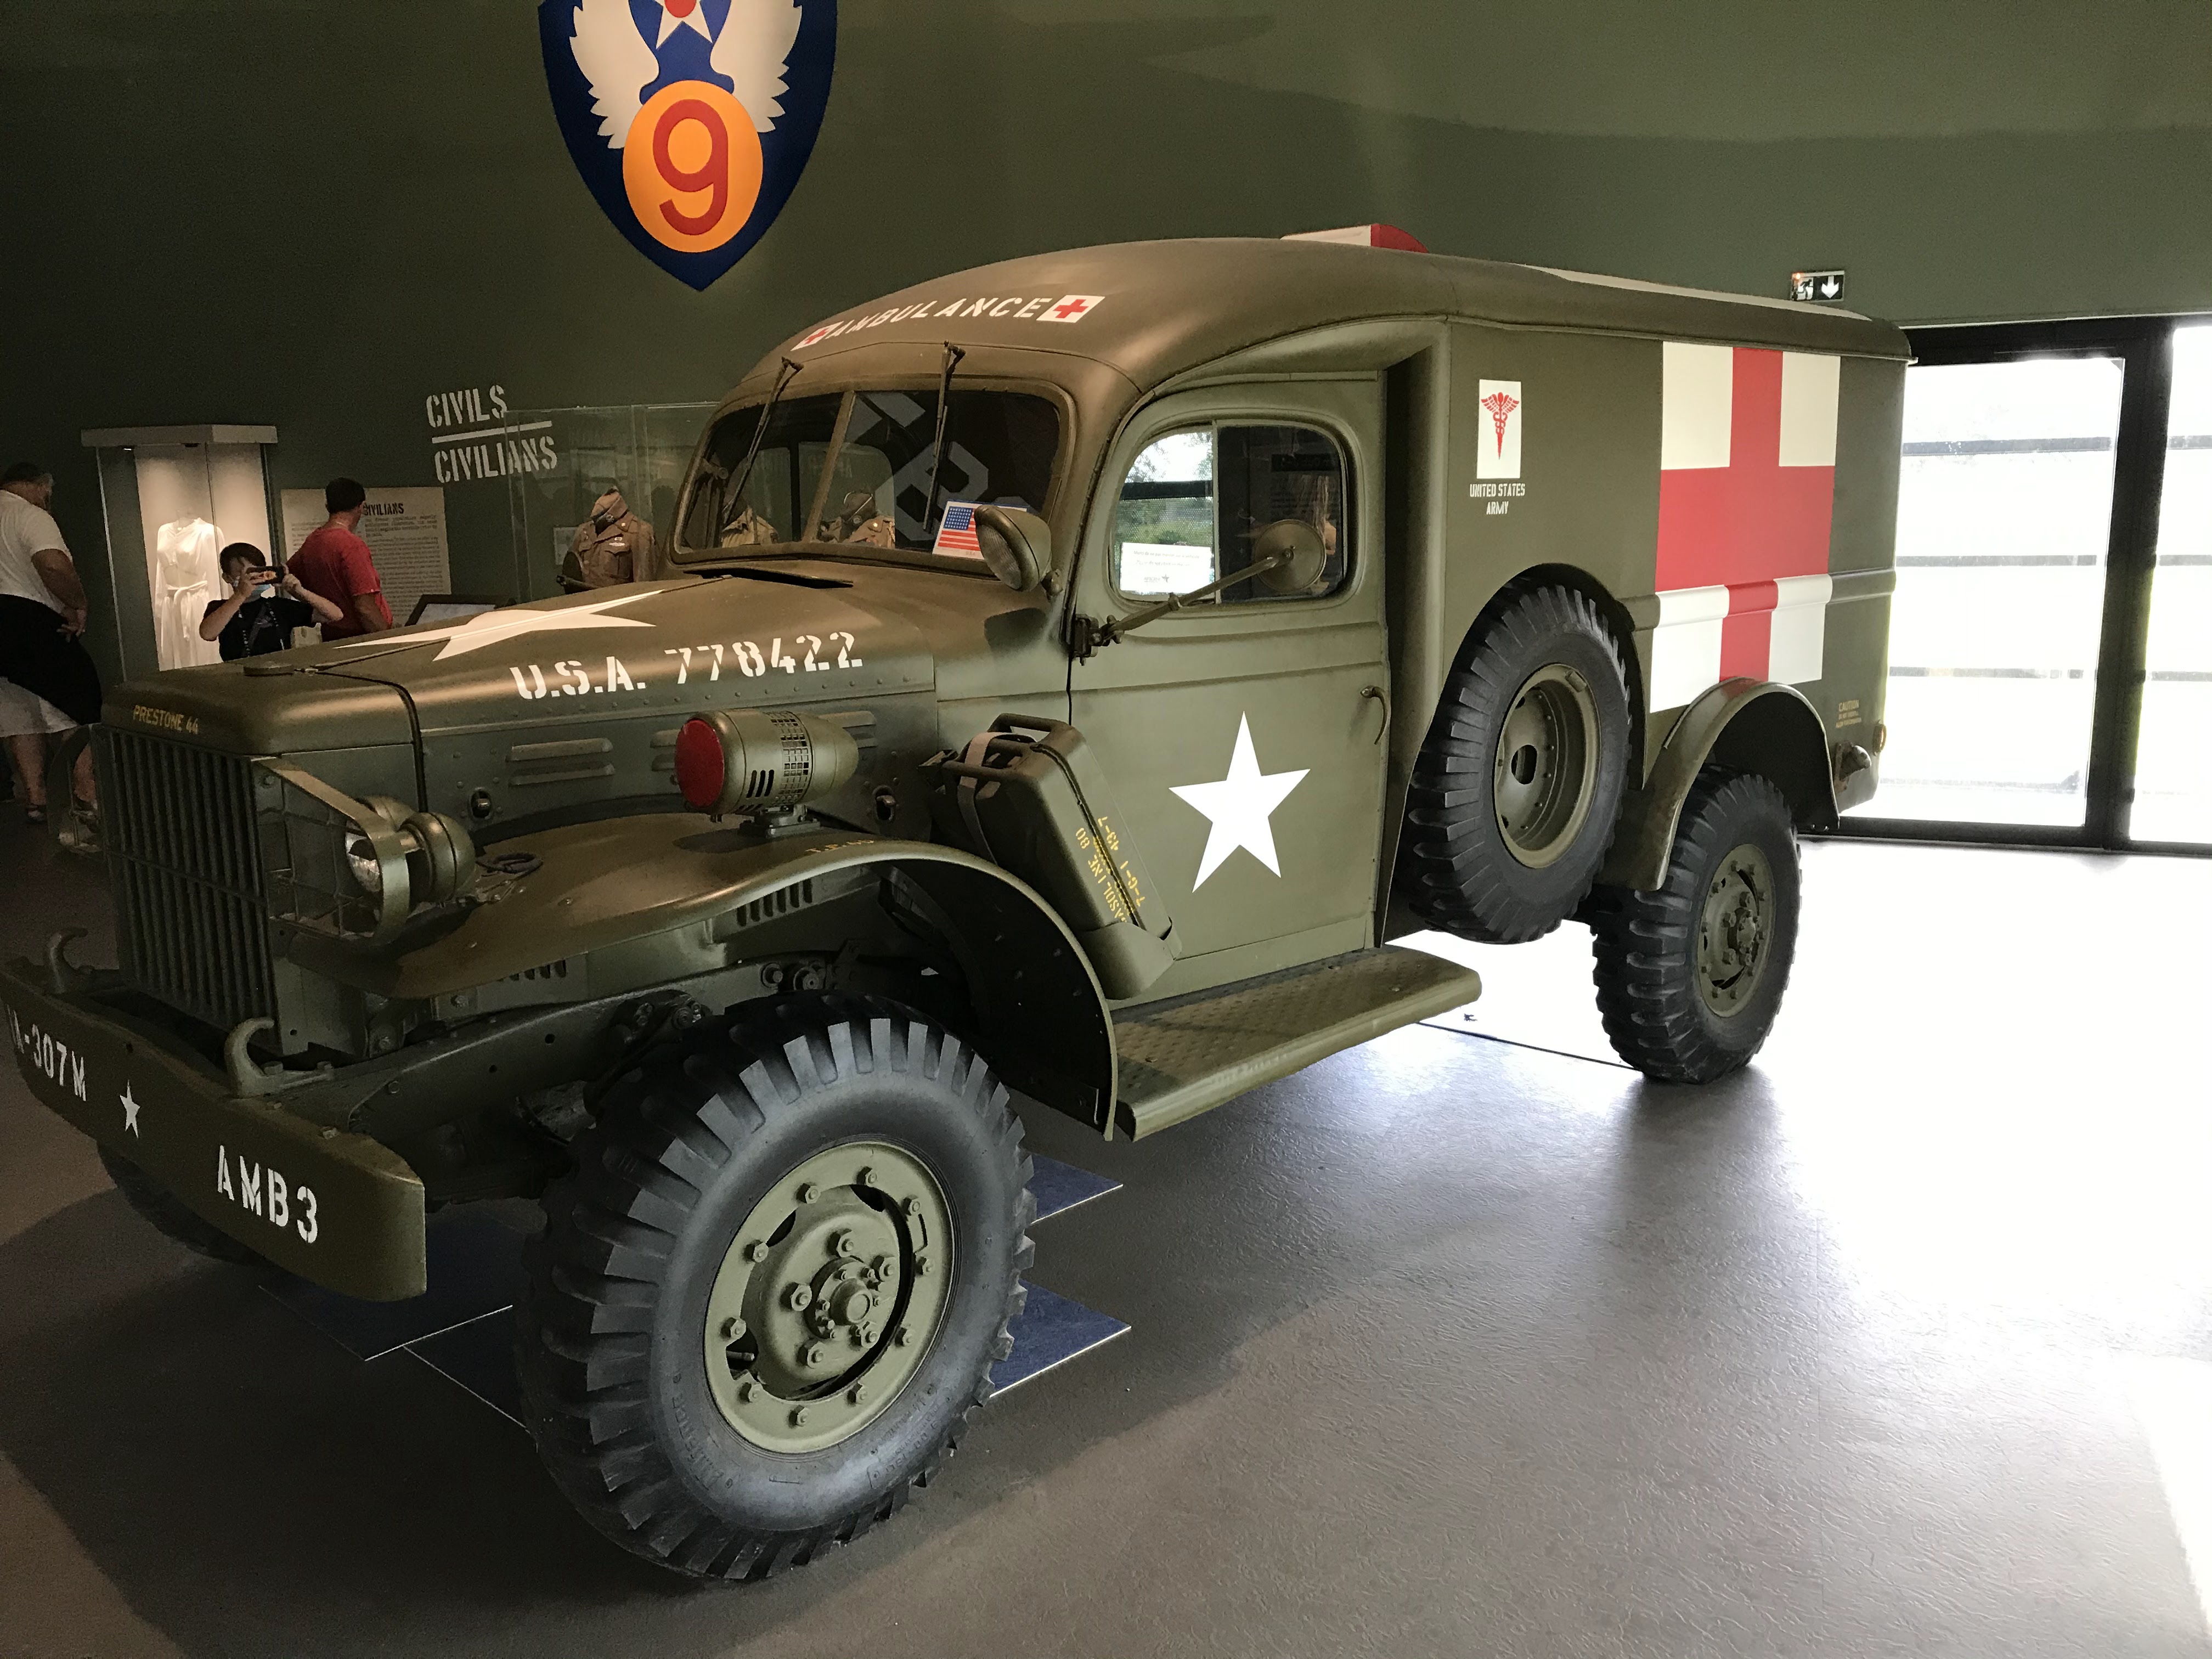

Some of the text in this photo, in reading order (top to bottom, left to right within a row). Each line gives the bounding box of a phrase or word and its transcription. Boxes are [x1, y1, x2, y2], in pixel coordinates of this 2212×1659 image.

[653, 99, 729, 236] 9
[825, 297, 1052, 340] AMBULANCE
[426, 385, 507, 427] CIVILS
[435, 436, 557, 483] CIVILIANS
[1470, 483, 1526, 497] UNITED STATES
[1486, 501, 1509, 515] ARMY
[510, 632, 863, 699] U.S.A. 778422
[133, 705, 184, 732] PRESTONE
[1075, 827, 1090, 849] 80
